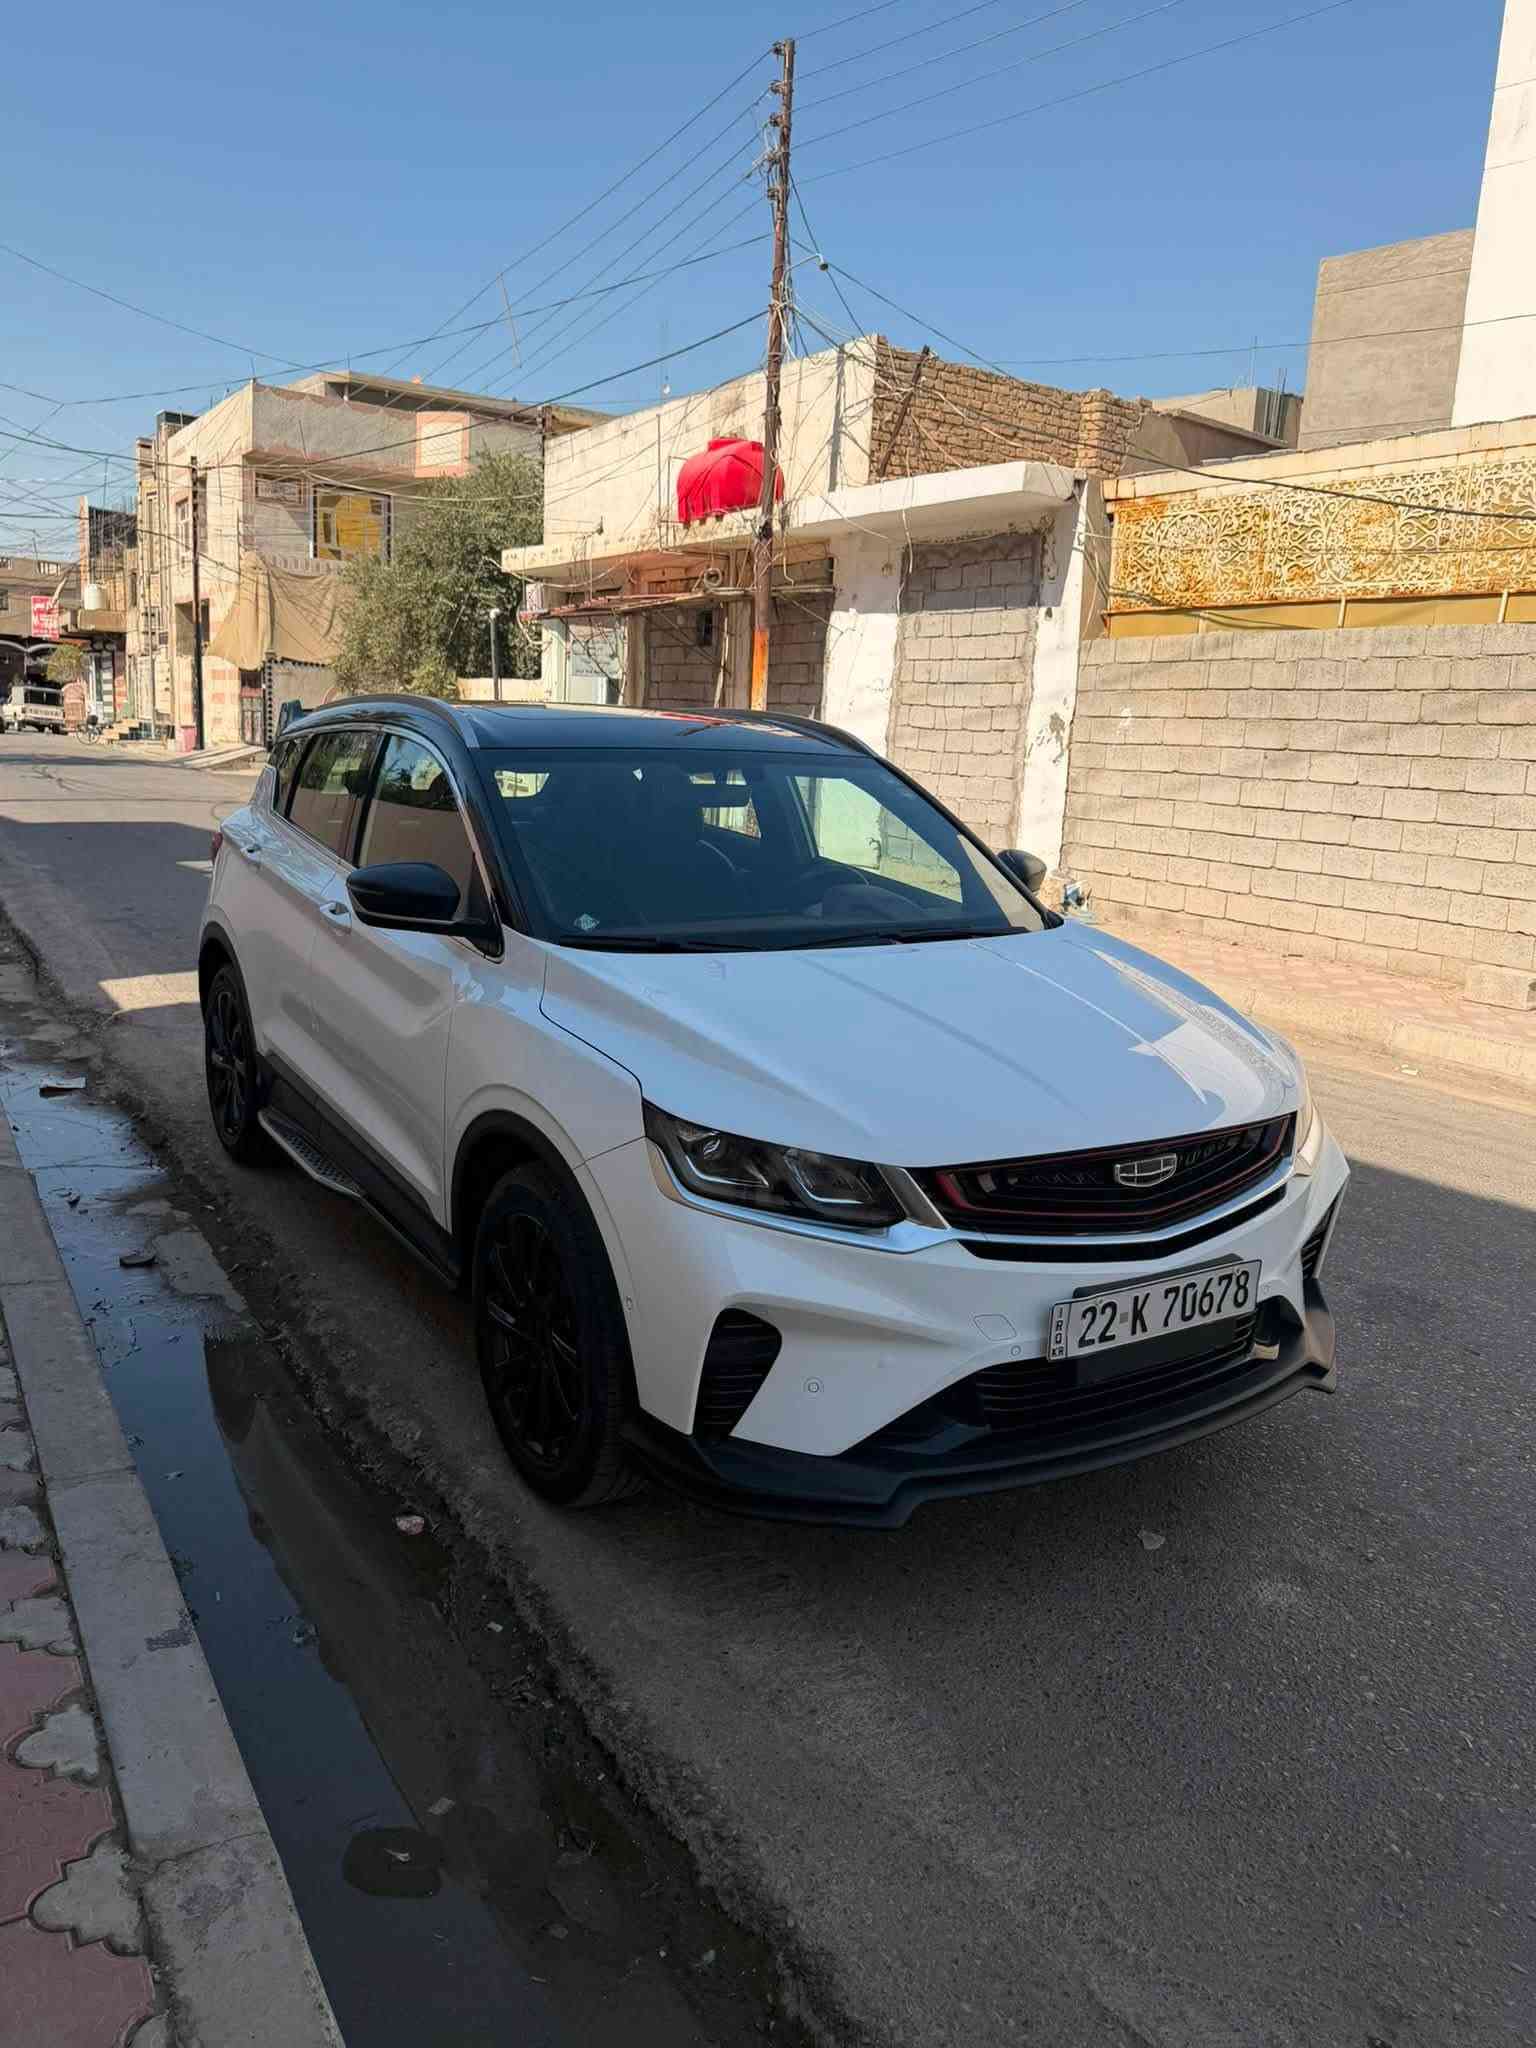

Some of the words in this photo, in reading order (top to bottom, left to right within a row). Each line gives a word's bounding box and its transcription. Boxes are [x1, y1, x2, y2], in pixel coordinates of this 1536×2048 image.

[1078, 1301, 1118, 1348] 22
[1130, 1292, 1150, 1336] K
[1163, 1269, 1250, 1328] 70678
